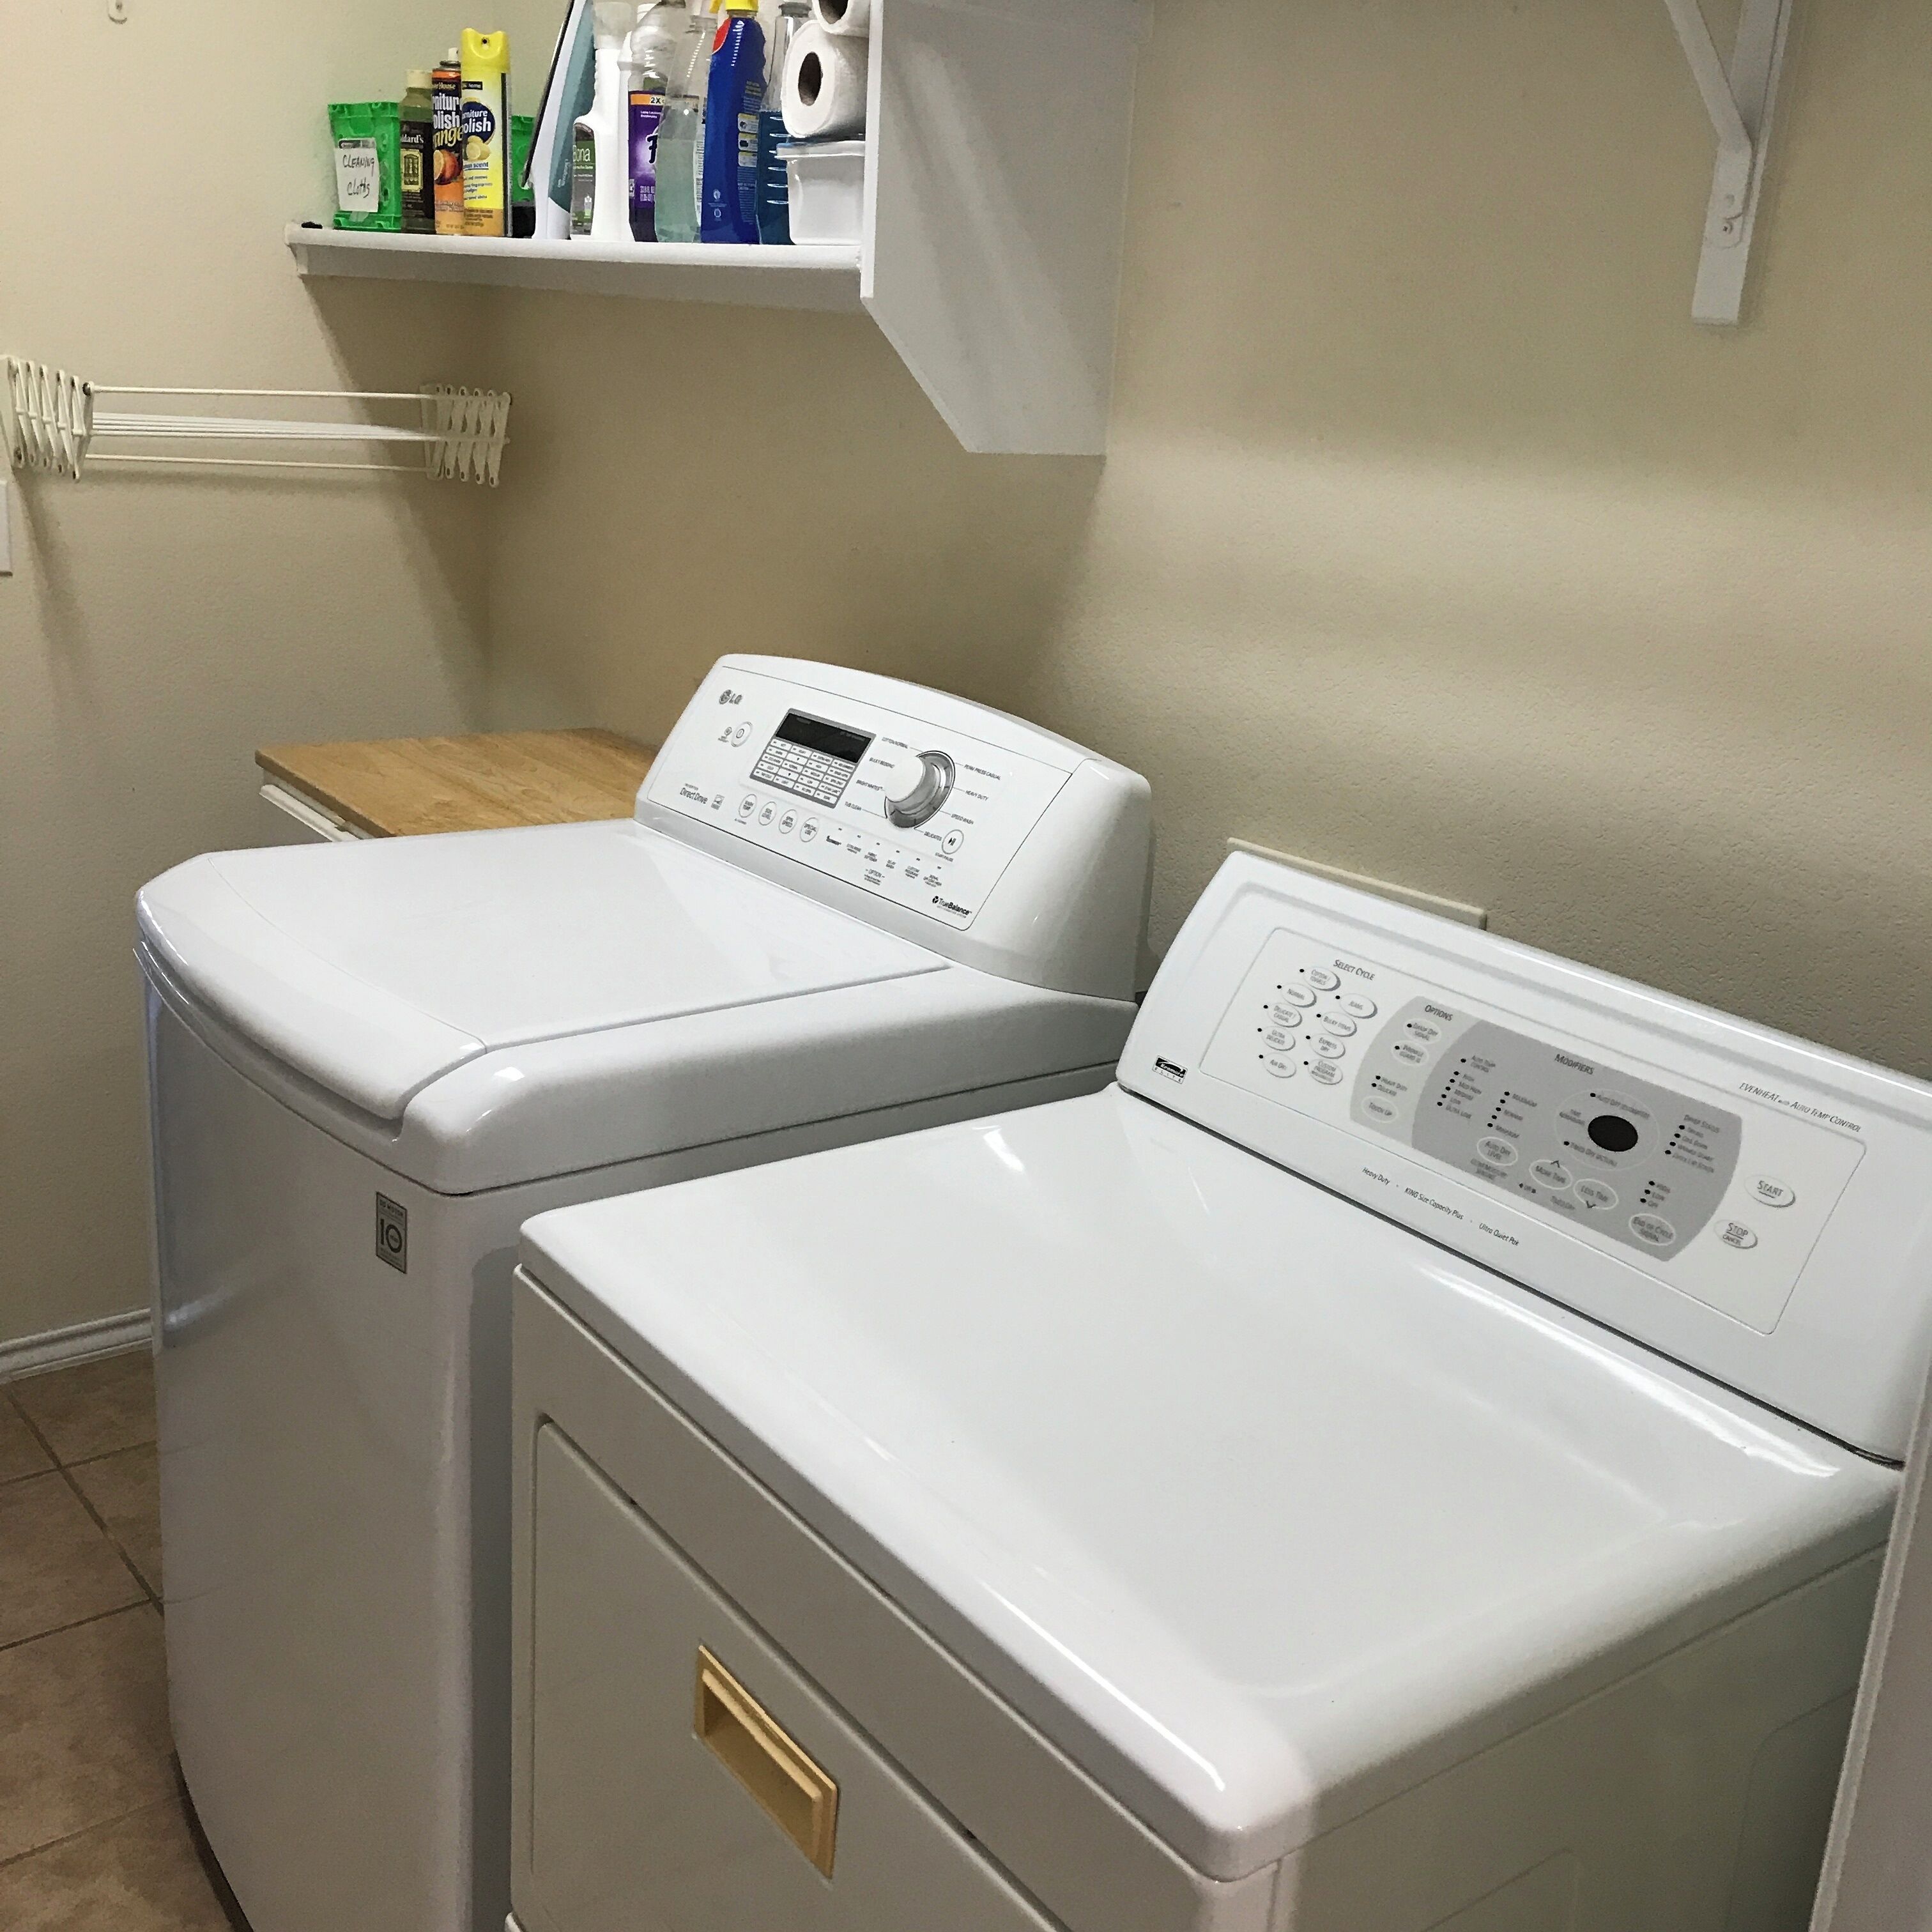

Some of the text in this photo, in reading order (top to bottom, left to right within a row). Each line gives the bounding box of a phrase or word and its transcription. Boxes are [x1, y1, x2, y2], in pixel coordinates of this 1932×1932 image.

[463, 117, 491, 134] olish
[1333, 959, 1375, 981] SELECT CYCLE
[1425, 1004, 1453, 1022] OPTIONS
[1554, 1054, 1595, 1075] MODIFIERS
[1739, 1082, 1780, 1103] EVENHEAT
[1829, 1115, 1862, 1133] CONTROL
[1362, 1167, 1390, 1185] Heavy Duty
[1404, 1187, 1418, 1198] KING
[1419, 1193, 1429, 1204] Size
[1756, 1180, 1784, 1197] START
[1479, 1222, 1493, 1234] Ultra
[1493, 1229, 1509, 1242] Quiet
[1726, 1222, 1749, 1237] STOP
